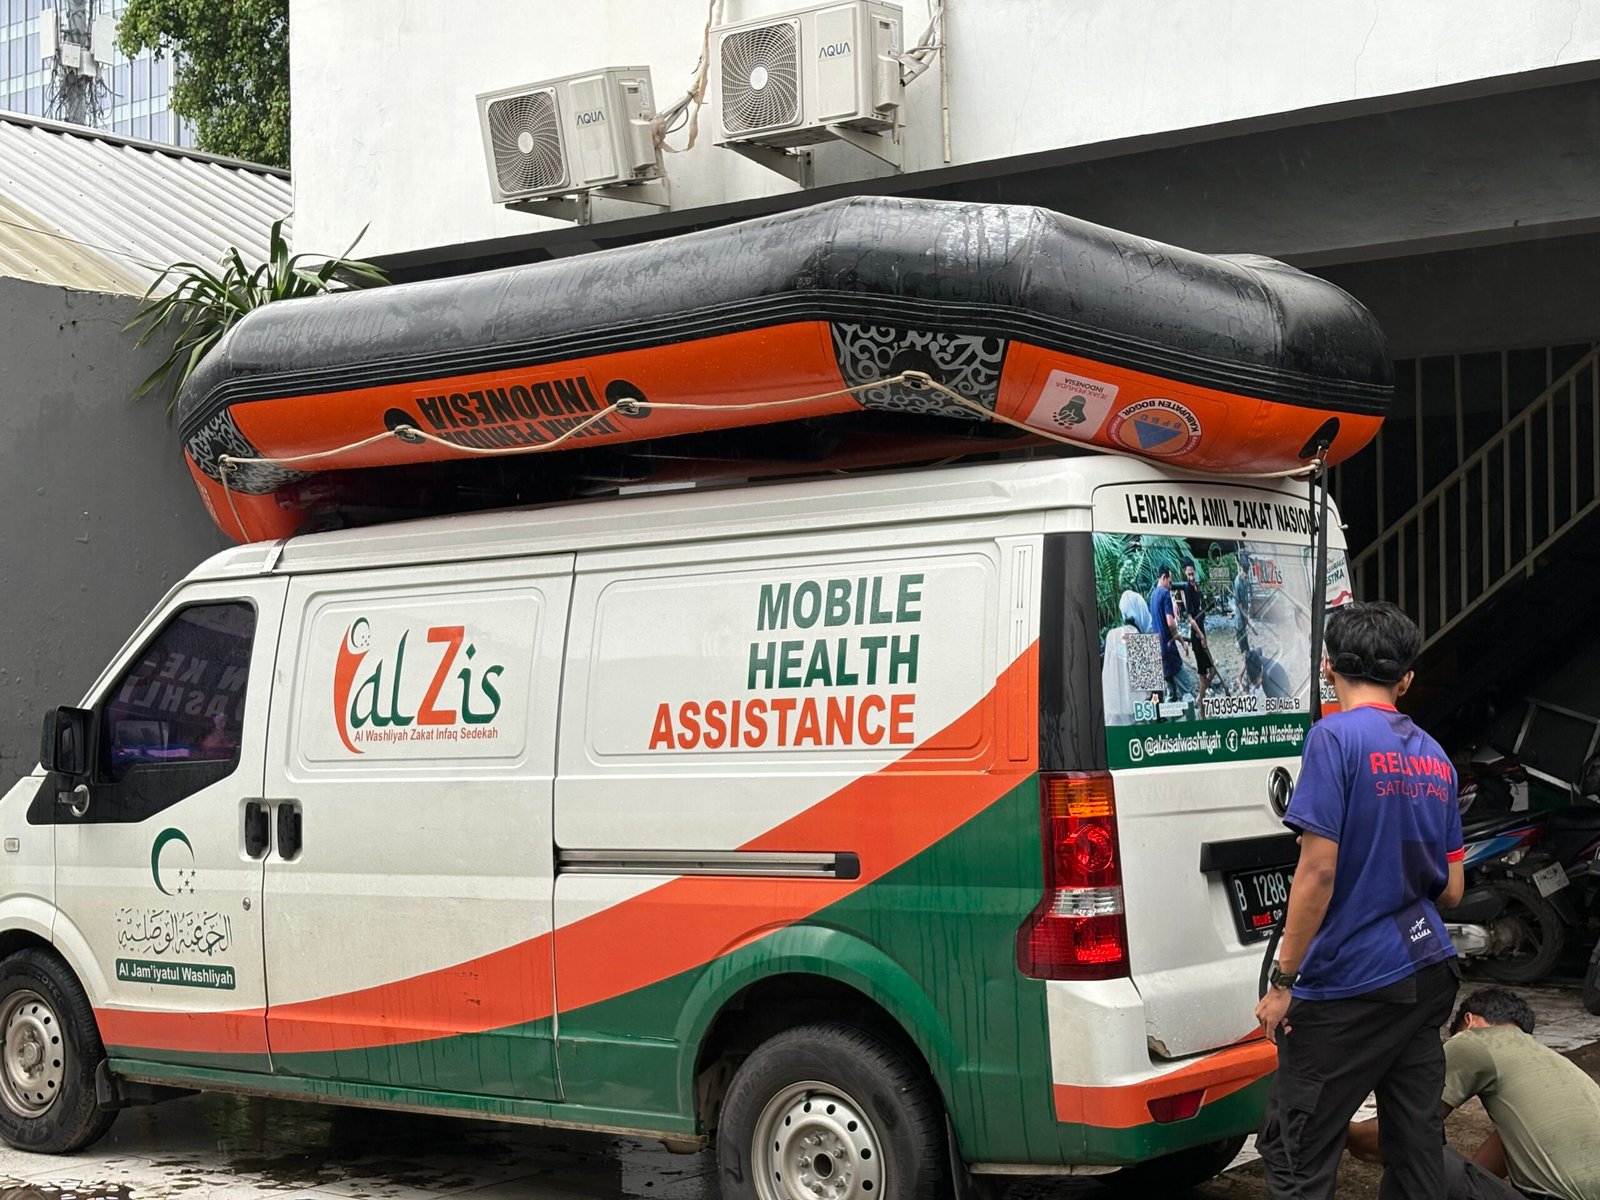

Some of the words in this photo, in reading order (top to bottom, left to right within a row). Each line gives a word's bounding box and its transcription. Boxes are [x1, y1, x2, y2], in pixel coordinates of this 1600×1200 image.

[819, 42, 851, 59] AQUA
[576, 110, 605, 126] AQUA
[1056, 382, 1087, 395] PEMUDA
[1064, 377, 1104, 393] INDONESIA
[415, 376, 600, 430] INDONESIA
[1123, 400, 1156, 417] BOGOR
[1157, 400, 1200, 433] KABUPATEN
[1125, 494, 1199, 526] LEMBAGA
[1201, 498, 1234, 528] AMIL
[1233, 500, 1273, 531] ZAKAT
[757, 573, 925, 631] MOBILE
[747, 634, 920, 690] HEALTH
[1134, 700, 1158, 720] BSI
[1203, 696, 1258, 716] 7193954132
[648, 693, 916, 750] ASSISTANCE
[354, 730, 364, 742] Al
[365, 729, 408, 744] Washliyah
[410, 728, 434, 741] Zakat
[436, 727, 458, 742] Infaq
[460, 726, 499, 740] Sedekah
[1145, 730, 1222, 756] @alzisalwashliyah
[1241, 726, 1260, 746] Alzis
[1260, 725, 1269, 744] Al
[1269, 723, 1304, 747] Washliyah
[1234, 879, 1248, 911] B
[1253, 872, 1288, 907] 1288
[119, 962, 129, 976] Al
[181, 966, 234, 987] Washliyah
